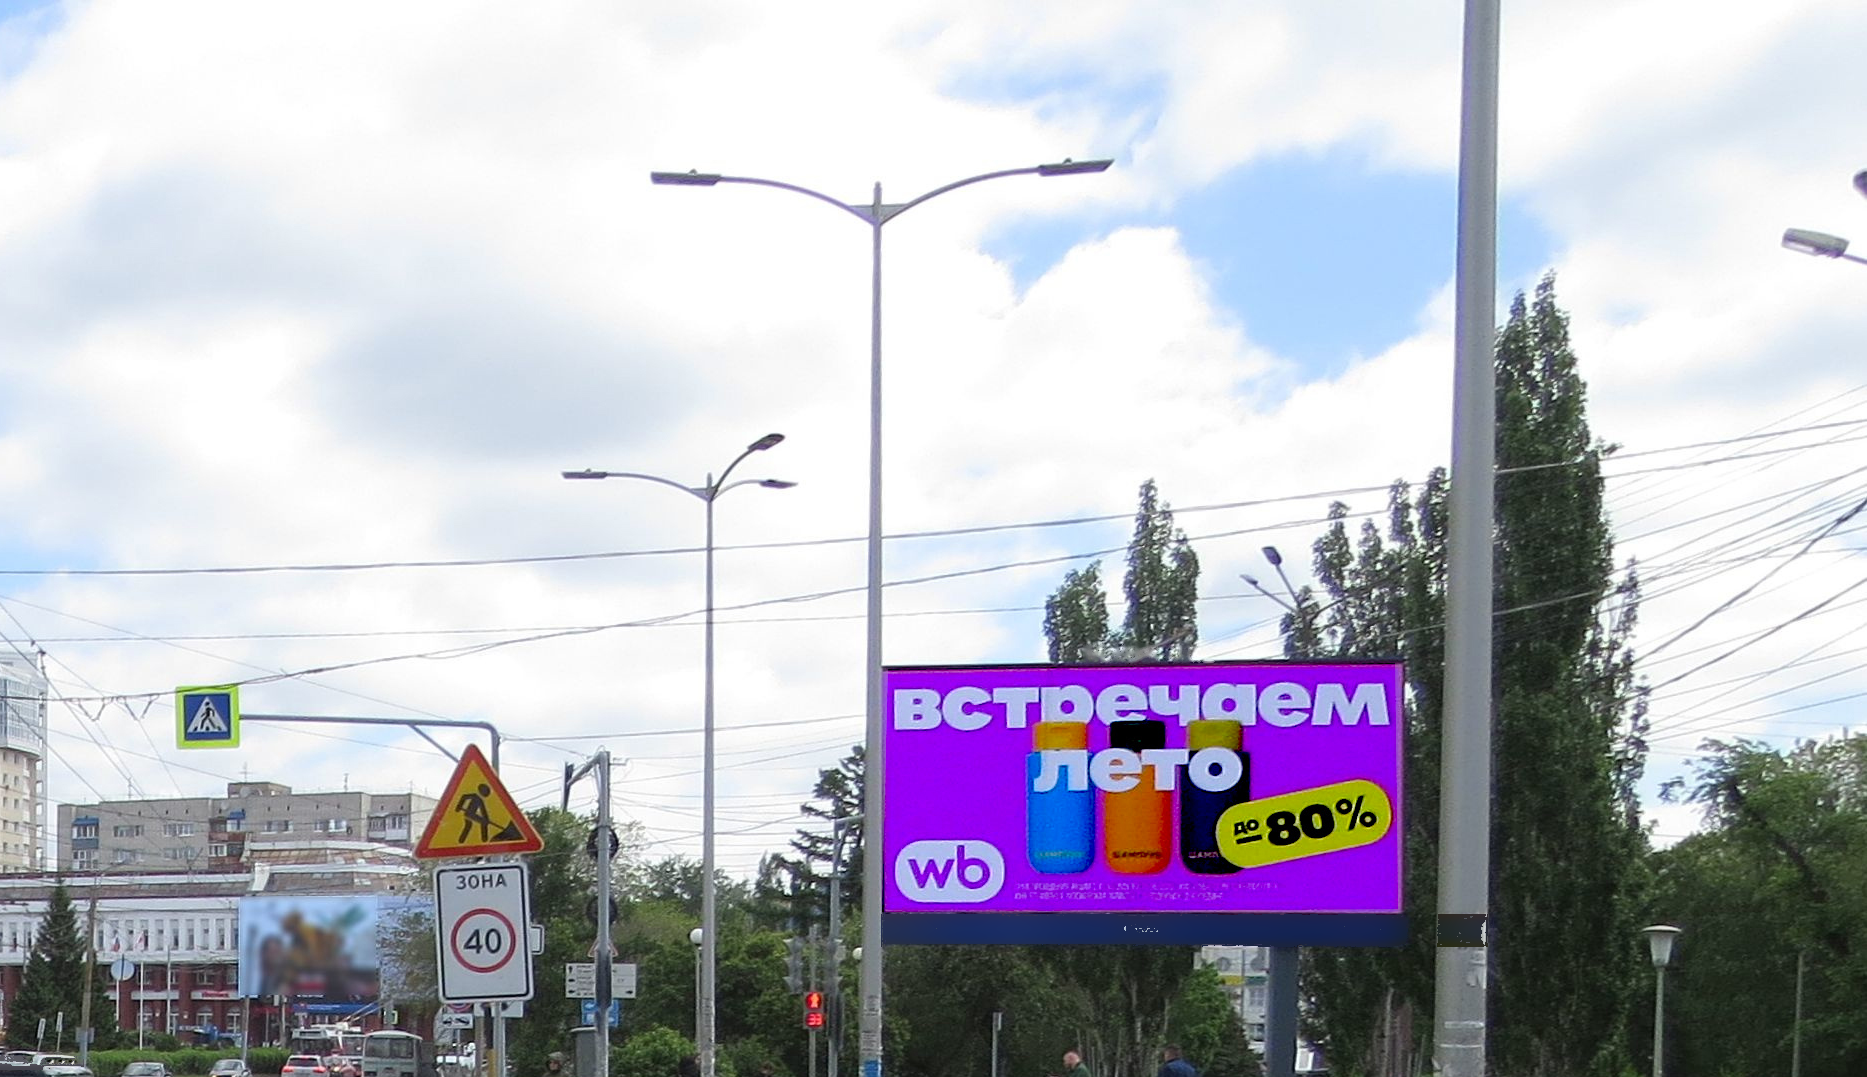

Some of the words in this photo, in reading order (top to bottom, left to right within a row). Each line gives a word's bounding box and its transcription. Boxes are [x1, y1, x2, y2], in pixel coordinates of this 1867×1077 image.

[894, 682, 1390, 731] встречаем
[1034, 746, 1243, 793] лето
[456, 873, 507, 890] ЗОНА
[907, 844, 991, 889] wb
[463, 928, 502, 954] 40
